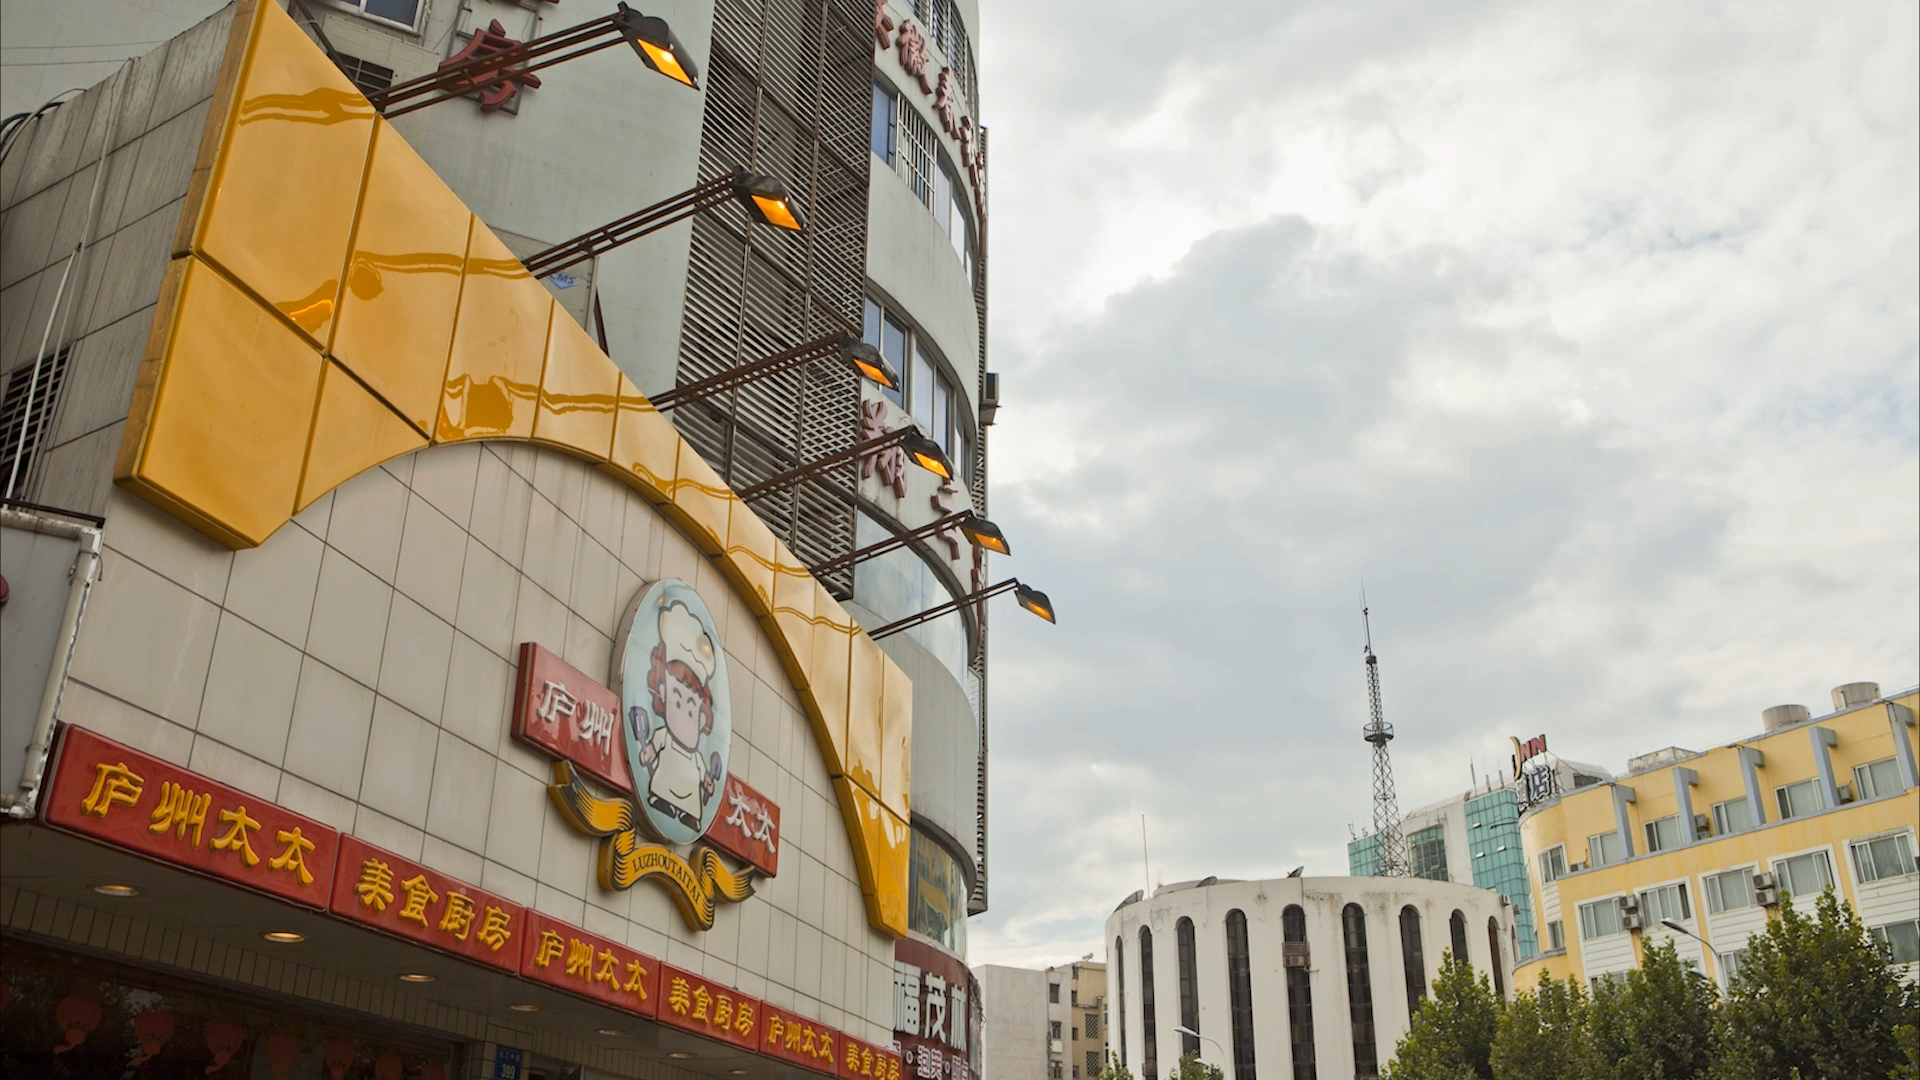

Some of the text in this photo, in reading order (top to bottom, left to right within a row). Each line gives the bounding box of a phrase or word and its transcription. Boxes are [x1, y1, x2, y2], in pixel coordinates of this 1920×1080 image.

[537, 680, 776, 854] 庐州 太太
[81, 761, 317, 888] 庐州太太
[354, 857, 512, 952] 美食厨房
[632, 853, 701, 904] LUZHOUTAITAI
[535, 929, 648, 1001] 庐州太太
[668, 976, 754, 1037] 美食厨房
[767, 1014, 834, 1064] 庐州太太
[846, 1041, 901, 1080] 美食厨房
[501, 1063, 516, 1079] 399
